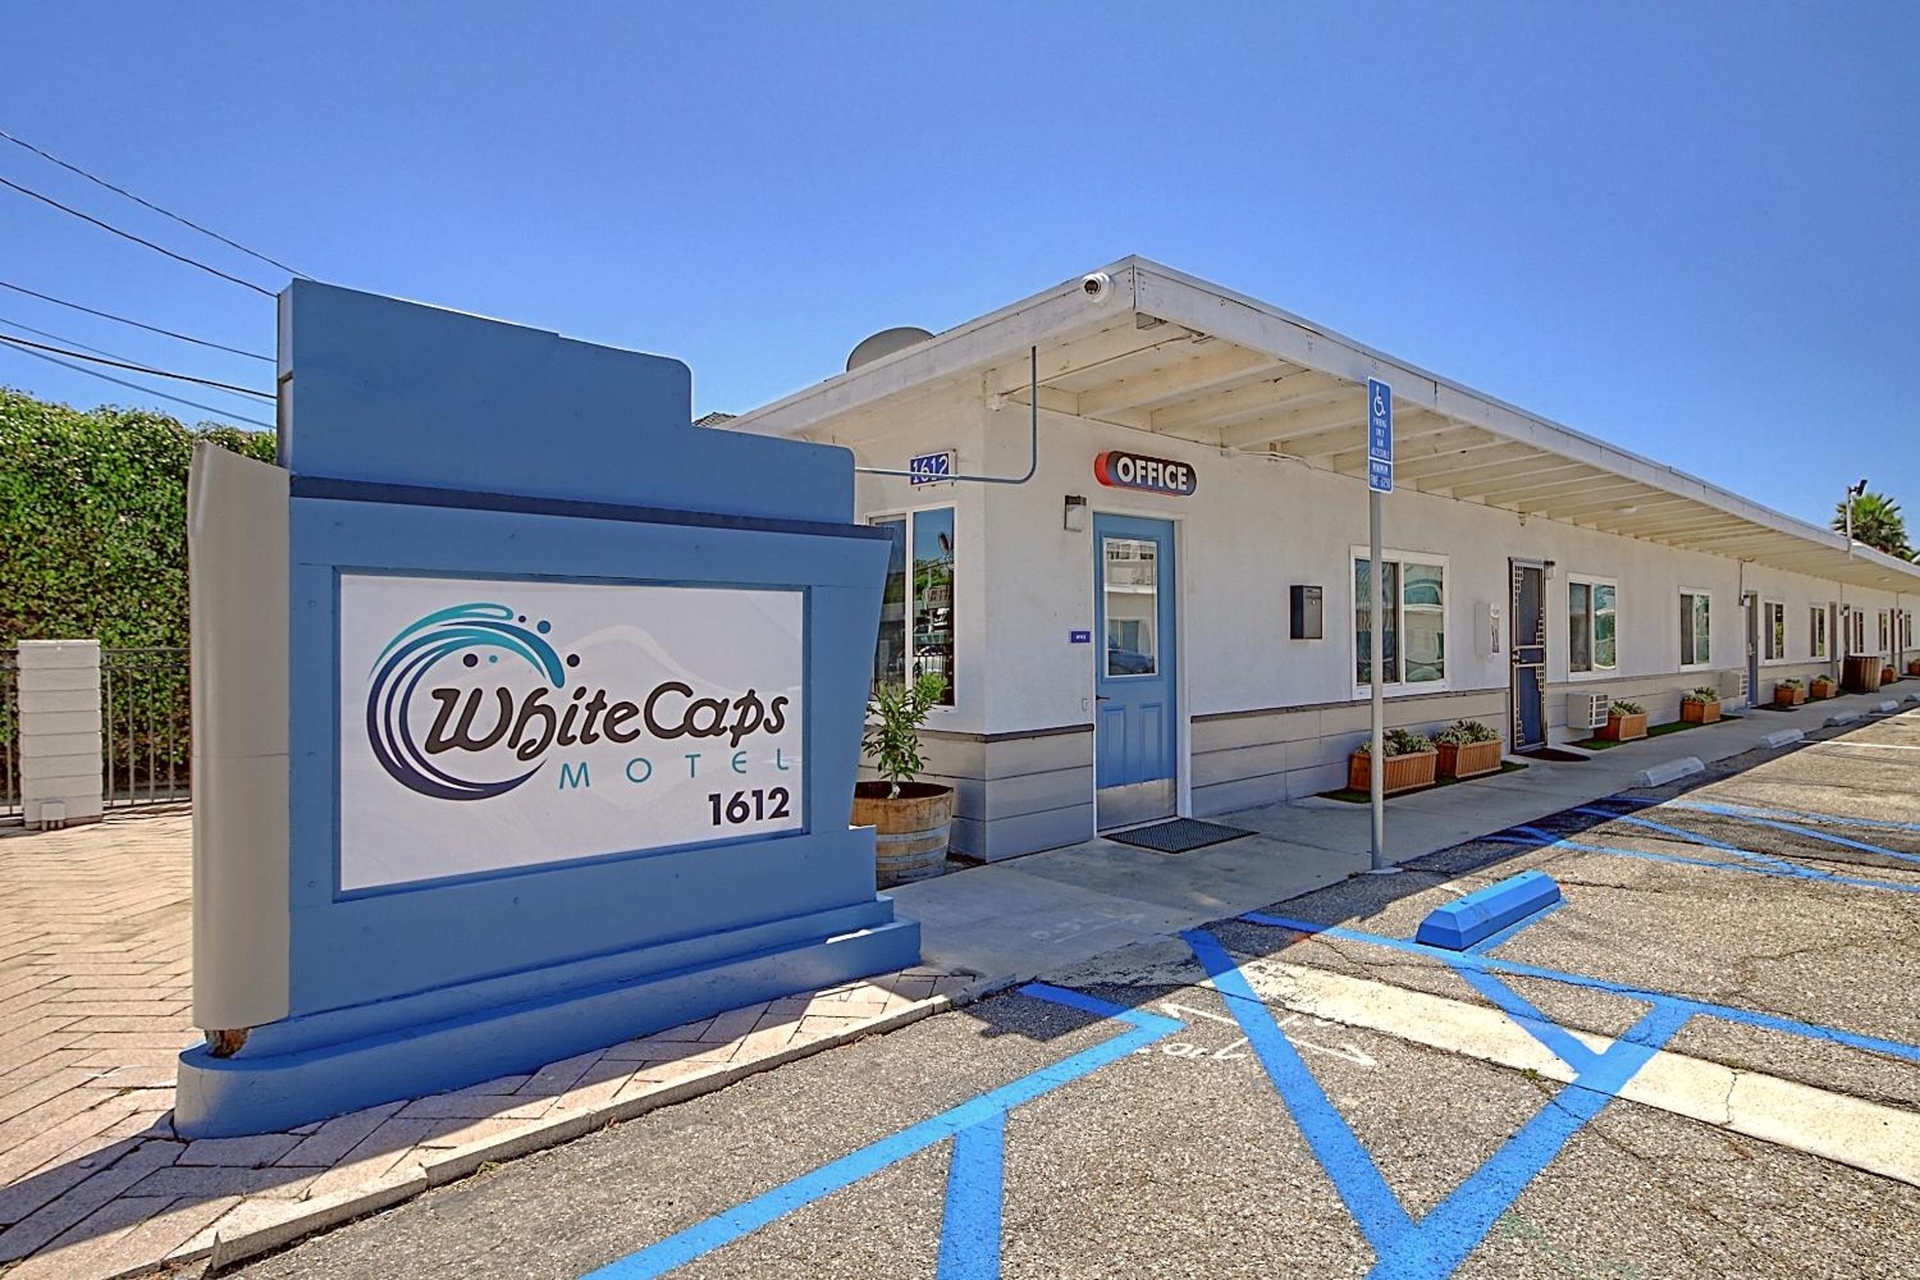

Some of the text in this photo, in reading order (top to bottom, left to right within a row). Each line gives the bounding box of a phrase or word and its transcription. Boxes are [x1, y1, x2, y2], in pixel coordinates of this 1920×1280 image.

[913, 455, 948, 483] 1612
[1117, 456, 1187, 491] OFFICE
[424, 681, 789, 761] WhiteCaps
[558, 748, 789, 790] MOTEL
[708, 786, 790, 826] 1612
